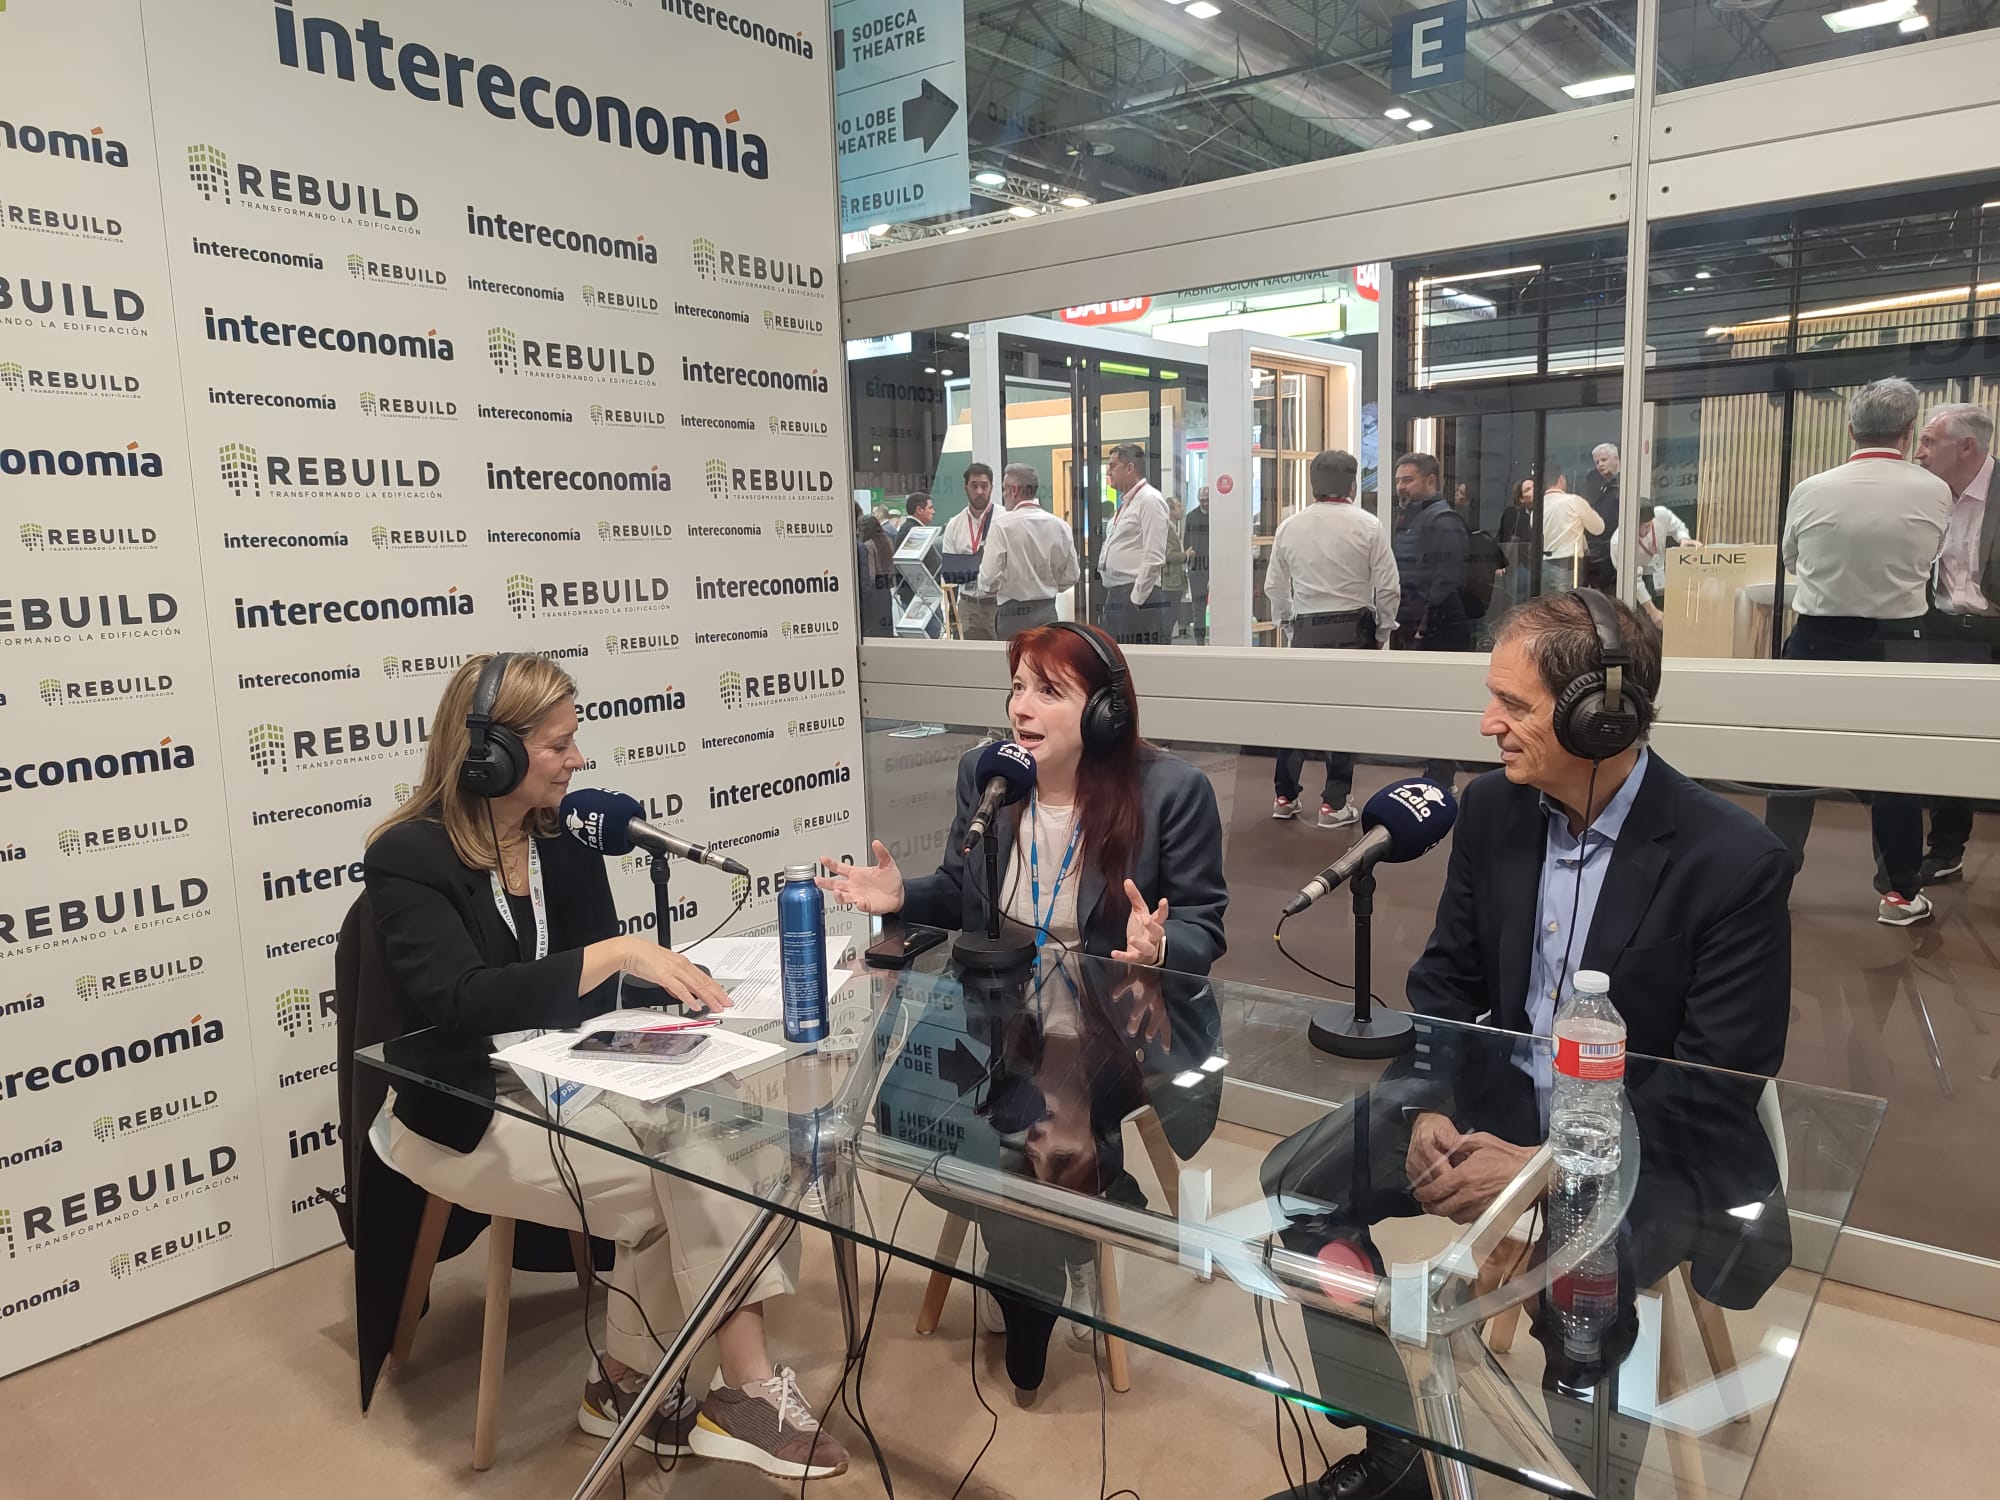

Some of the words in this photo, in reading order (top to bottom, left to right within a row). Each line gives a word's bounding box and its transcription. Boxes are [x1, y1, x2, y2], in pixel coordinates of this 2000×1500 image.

[852, 8, 917, 43] SODECA
[852, 26, 926, 63] THEATRE
[1410, 16, 1445, 79] E
[274, 0, 769, 180] intereconomía
[856, 106, 897, 132] LOBE
[237, 163, 419, 222] REBUILD
[850, 183, 924, 215] REBUILD
[8, 205, 122, 236] REBUILD
[239, 200, 336, 222] TRANSFORMANDO
[341, 215, 353, 225] LA
[467, 205, 658, 264] intereconomía
[192, 237, 324, 270] intereconomía
[368, 261, 447, 285] REBUILD
[720, 250, 823, 289] REBUILD
[467, 275, 565, 302] intereconomía
[597, 291, 658, 310] REBUILD
[674, 302, 750, 323] intereconomía
[775, 315, 823, 332] REBUILD
[40, 319, 56, 329] LA
[64, 322, 148, 336] EDIFICACIÓN
[204, 306, 454, 361] intereconomía
[523, 340, 655, 377] REBUILD
[28, 369, 140, 392] REBUILD
[524, 370, 594, 382] TRANSFORMANDO
[597, 376, 607, 384] LA
[682, 356, 828, 393] intereconomía
[208, 387, 336, 410] intereconomía
[379, 398, 457, 416] REBUILD
[477, 404, 573, 423] intereconomía
[605, 409, 665, 424] REBUILD
[680, 414, 756, 430] intereconomía
[780, 420, 828, 433] REBUILD
[266, 456, 441, 487] REBUILD
[486, 461, 671, 491] intereconomía
[732, 468, 833, 492] REBUILD
[269, 490, 361, 499] TRANSFORMANDO
[366, 490, 377, 499] LA
[382, 490, 442, 499] EDIFICACIÓN
[48, 528, 157, 545] REBUILD
[223, 530, 349, 549] intereconomía
[390, 529, 467, 544] REBUILD
[487, 528, 581, 543] intereconomía
[612, 524, 672, 537] REBUILD
[687, 524, 762, 537] intereconomía
[786, 523, 833, 534] REBUILD
[540, 577, 670, 608] REBUILD
[695, 569, 839, 600] intereconomía
[234, 585, 474, 629] intereconomía
[0, 634, 71, 646] ORMANDO
[79, 633, 93, 641] LA
[100, 627, 181, 640] EDIFICACIÓN
[694, 627, 768, 644] intereconomía
[793, 621, 839, 635] REBUILD
[620, 634, 679, 650] REBUILD
[66, 675, 173, 698] REBUILD
[238, 663, 361, 689] intereconomía
[745, 667, 845, 698] REBUILD
[574, 684, 686, 722] economía
[799, 716, 845, 733] REBUILD
[293, 716, 432, 760] REBUIL
[628, 741, 686, 761] REBUILD
[702, 728, 775, 749] intereconomía
[296, 753, 384, 772] TRANSFORMANDO
[1000, 747, 1031, 765] radio
[709, 761, 851, 809] intereconomía
[252, 794, 373, 826] intereconomía
[1394, 787, 1431, 818] radio
[84, 817, 189, 848] REBUILD
[584, 812, 598, 849] radio
[804, 810, 850, 829] REBUILD
[113, 926, 128, 935] LA
[134, 909, 211, 931] EDIFICACIÓN
[101, 956, 204, 991] REBUILD
[0, 1013, 224, 1100] reconomía
[279, 1061, 338, 1088] interec
[561, 1081, 579, 1098] PRE
[118, 1090, 218, 1131] REBUILD
[23, 1145, 237, 1241] REBUILD
[27, 1209, 139, 1253] TRANSFORMANDO
[145, 1202, 159, 1212] LA
[134, 1220, 232, 1267] REBUILD
[0, 1278, 80, 1319] onomía
